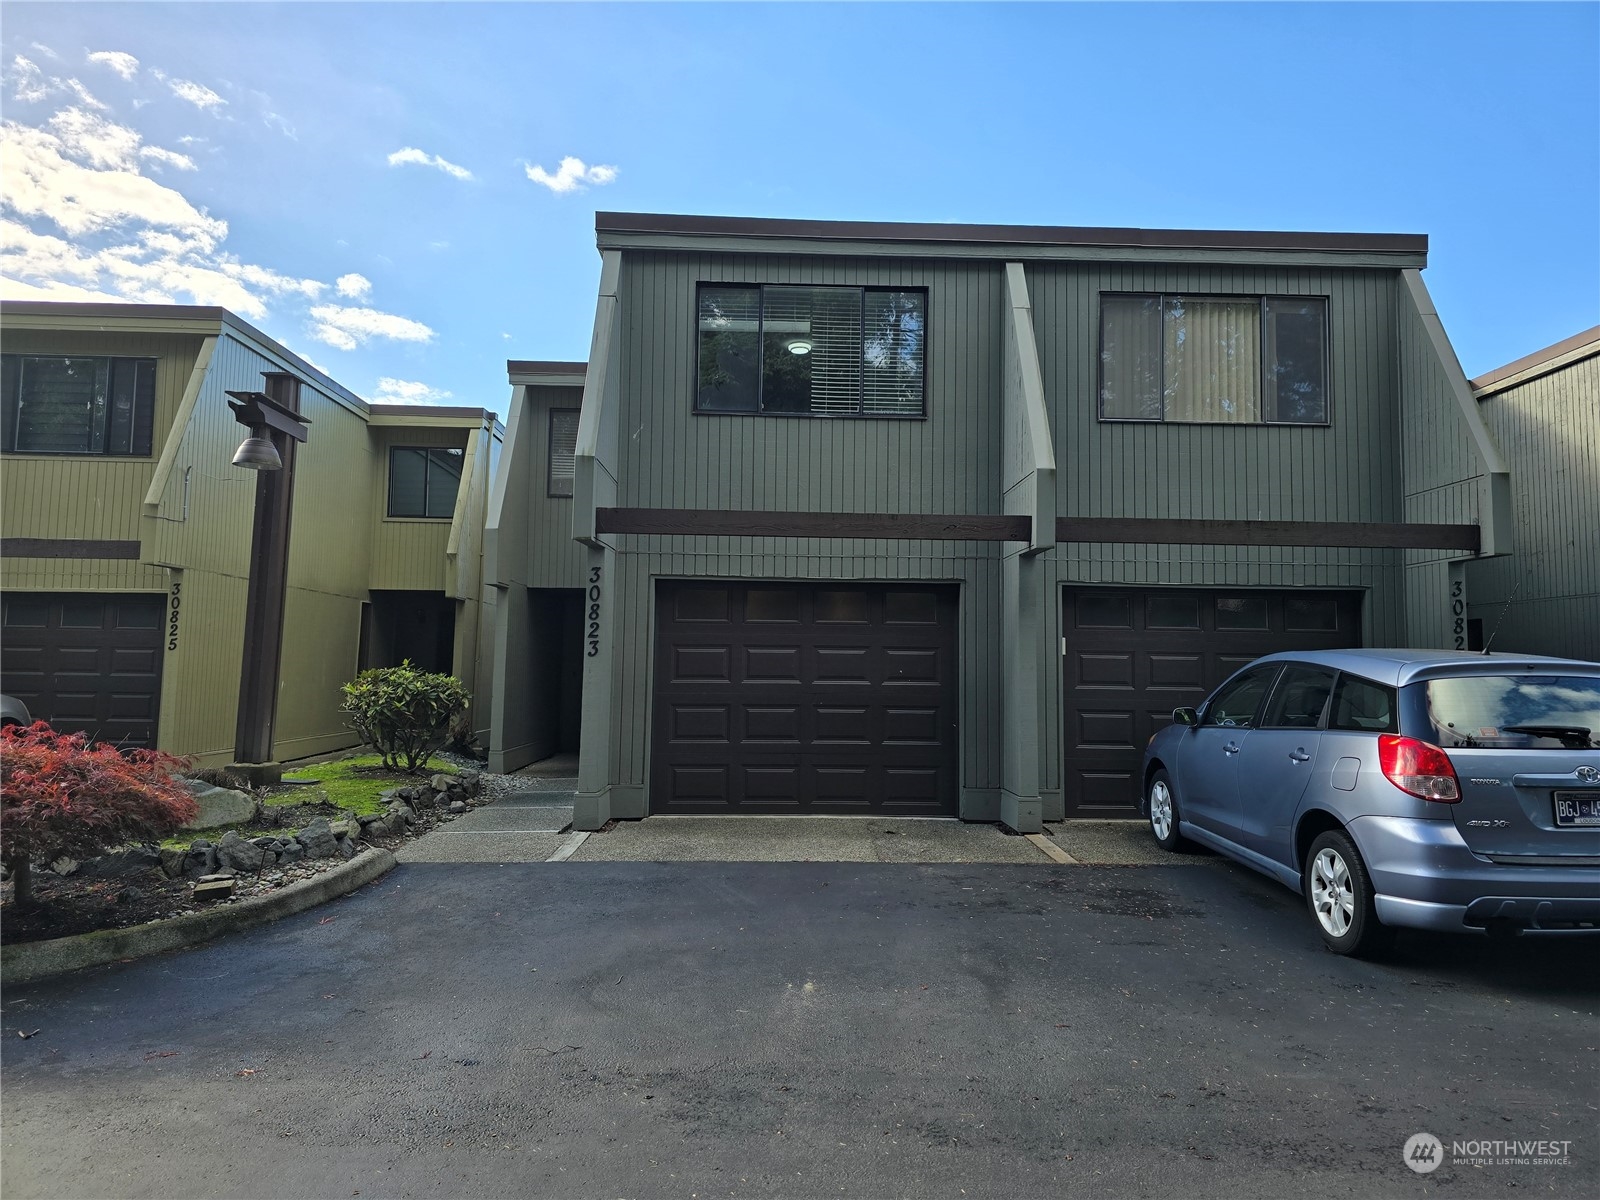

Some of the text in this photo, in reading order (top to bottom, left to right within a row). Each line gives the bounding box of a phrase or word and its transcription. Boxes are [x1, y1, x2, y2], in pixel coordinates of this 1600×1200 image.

[168, 583, 181, 651] 30825
[587, 566, 602, 657] 30823
[1558, 800, 1580, 817] BGJ
